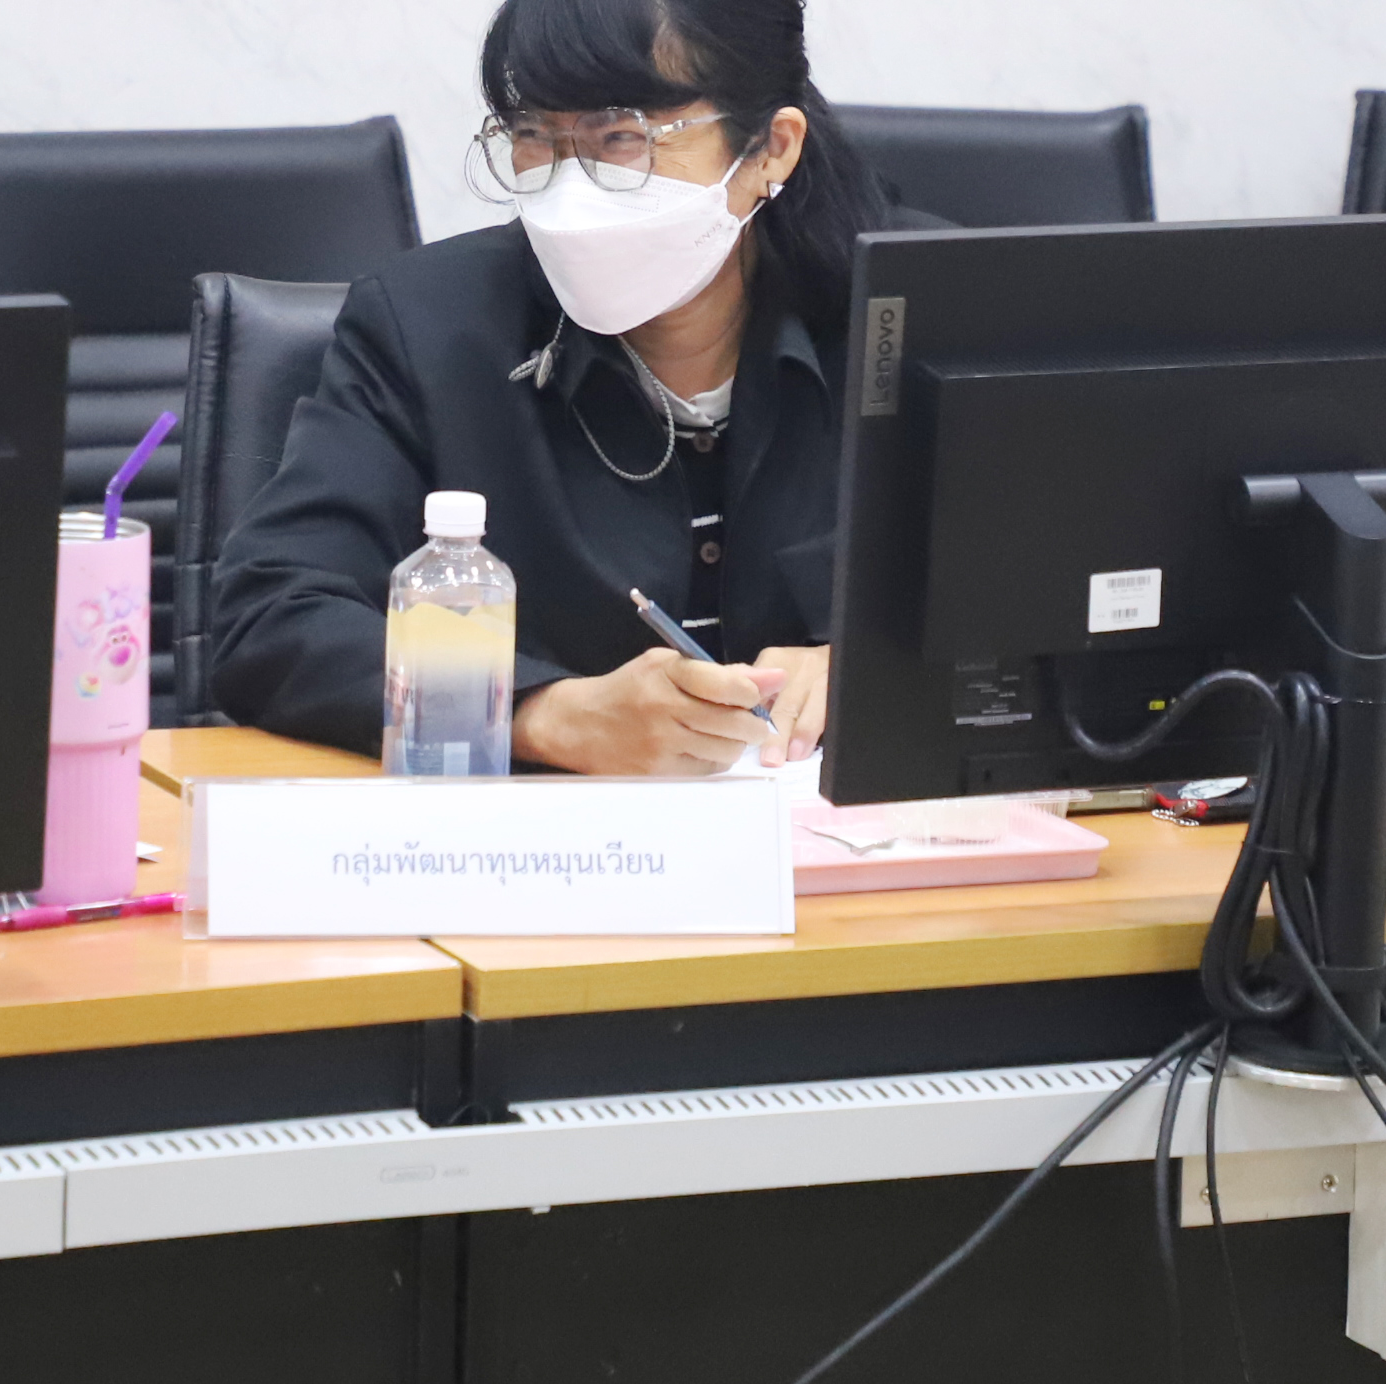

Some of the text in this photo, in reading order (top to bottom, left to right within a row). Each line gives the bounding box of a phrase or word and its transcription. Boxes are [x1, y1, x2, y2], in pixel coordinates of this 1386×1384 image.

[869, 308, 895, 406] Lenovo
[331, 841, 666, 886] กลุ่มพัฒนาทุนหมุนเวียน
